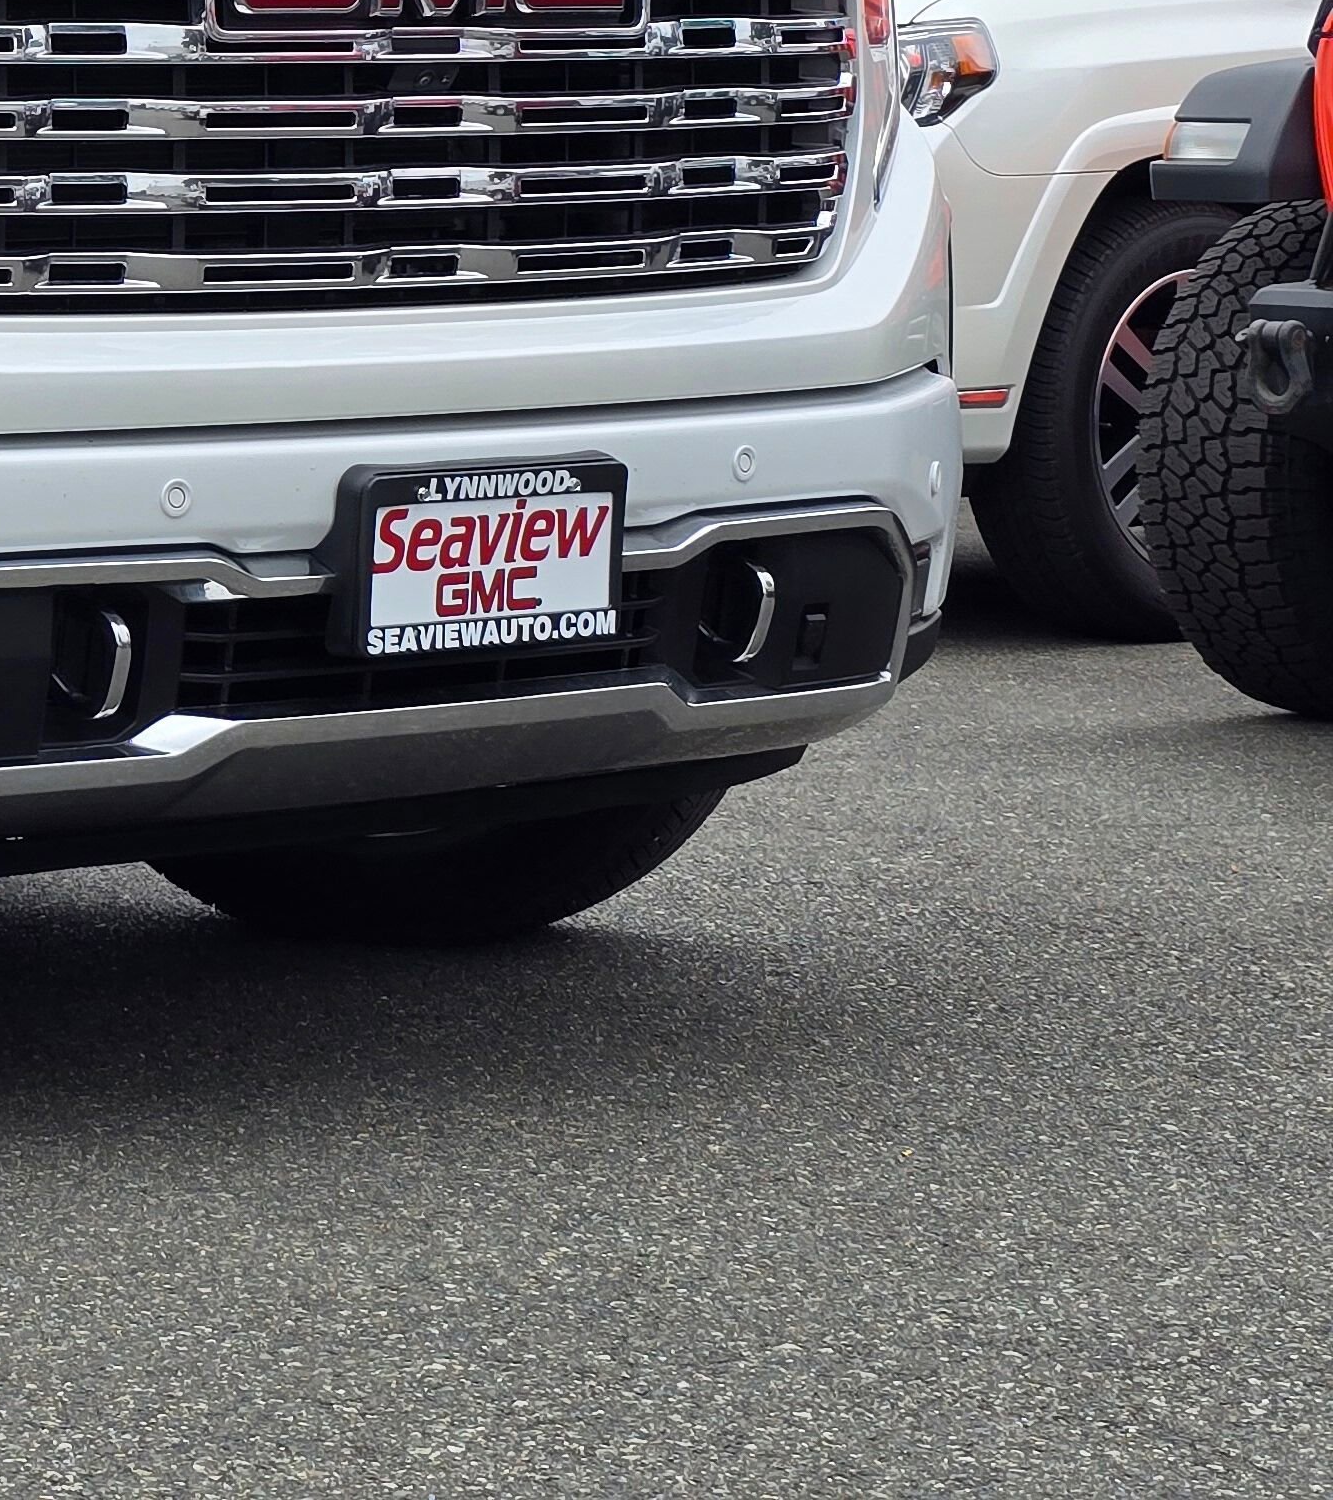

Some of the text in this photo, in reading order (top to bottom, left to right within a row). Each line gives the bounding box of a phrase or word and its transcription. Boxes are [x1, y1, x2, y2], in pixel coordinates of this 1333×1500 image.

[430, 470, 571, 501] LYNNWOOD
[372, 499, 610, 574] Seaview
[436, 566, 538, 617] GMC
[367, 610, 617, 655] SEAVIEWAUTO.COM
